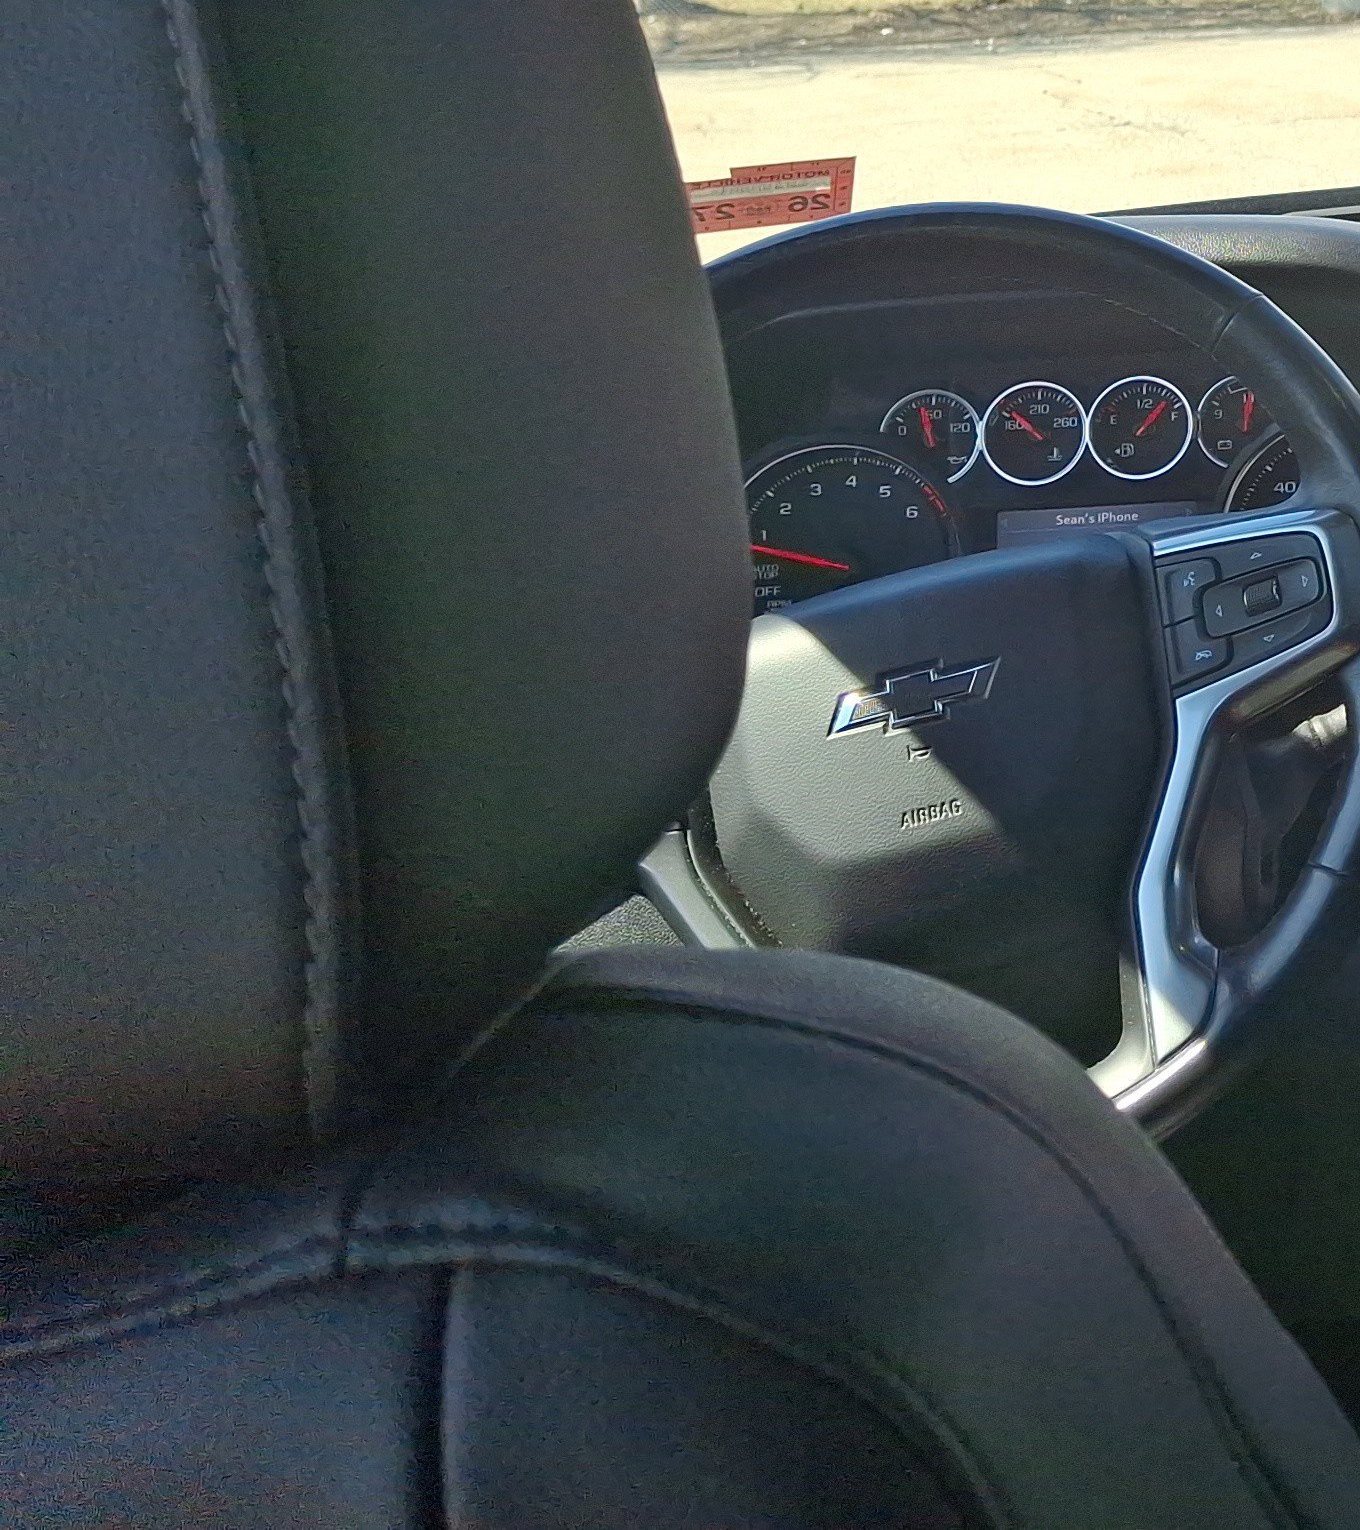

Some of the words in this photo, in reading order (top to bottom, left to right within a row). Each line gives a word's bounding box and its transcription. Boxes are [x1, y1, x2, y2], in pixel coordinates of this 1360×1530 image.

[1029, 404, 1050, 415] 210
[1136, 398, 1153, 410] 1/2
[1171, 412, 1179, 422] F
[1214, 409, 1223, 419] 9
[1053, 417, 1078, 428] 260
[1110, 415, 1117, 425] E
[898, 425, 907, 435] 0
[950, 422, 970, 433] 120
[845, 475, 858, 488] 4
[1273, 481, 1297, 493] 40
[810, 483, 822, 496] 3
[879, 485, 892, 498] 5
[779, 502, 792, 515] 2
[906, 506, 919, 519] 6
[1056, 513, 1095, 526] Sean's
[1097, 511, 1139, 524] iPhone
[761, 530, 767, 541] 1
[755, 586, 781, 597] OFF
[900, 799, 962, 831] AIRBAG
